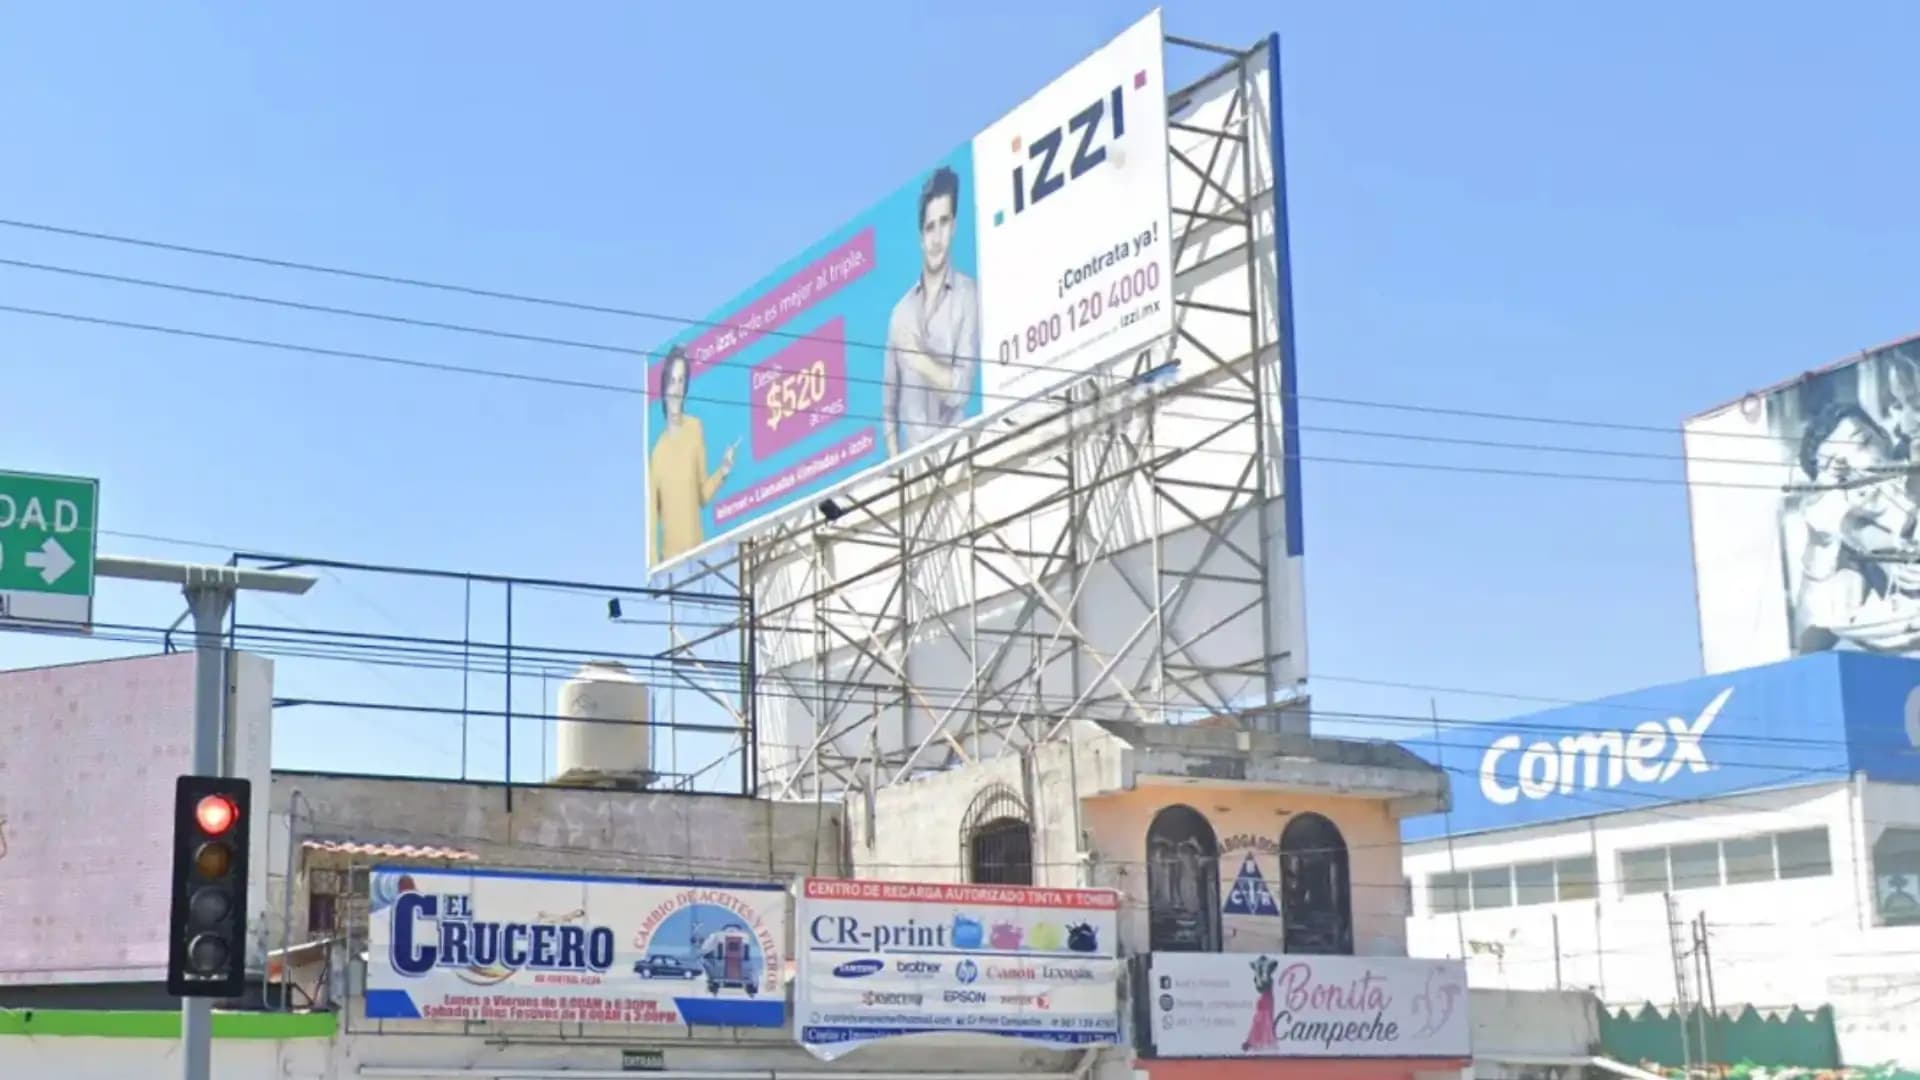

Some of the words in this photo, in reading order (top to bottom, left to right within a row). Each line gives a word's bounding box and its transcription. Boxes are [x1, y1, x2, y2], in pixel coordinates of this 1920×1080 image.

[1058, 242, 1129, 299] ¡Contrata
[1133, 221, 1158, 257] ya!
[999, 334, 1020, 366] 01
[1026, 314, 1061, 353] 800
[1067, 291, 1102, 332] 120
[1108, 261, 1160, 308] 4000
[1120, 300, 1161, 328] izzi.mx
[767, 359, 826, 432] $520
[443, 893, 474, 919] EL
[808, 882, 860, 896] CENTRO
[863, 883, 880, 897] DE
[883, 884, 943, 898] RECARGA
[945, 887, 1025, 902] AUTORIZADO
[1028, 890, 1063, 904] TINTA
[389, 891, 616, 978] CRUCERO
[633, 900, 675, 951] CAMBIO
[676, 890, 697, 907] DE
[697, 890, 754, 921] ACEITES
[811, 914, 946, 953] CR-print
[943, 990, 986, 1003] EPSON
[1279, 962, 1393, 1013] Bonita
[1272, 1010, 1400, 1050] Campeche
